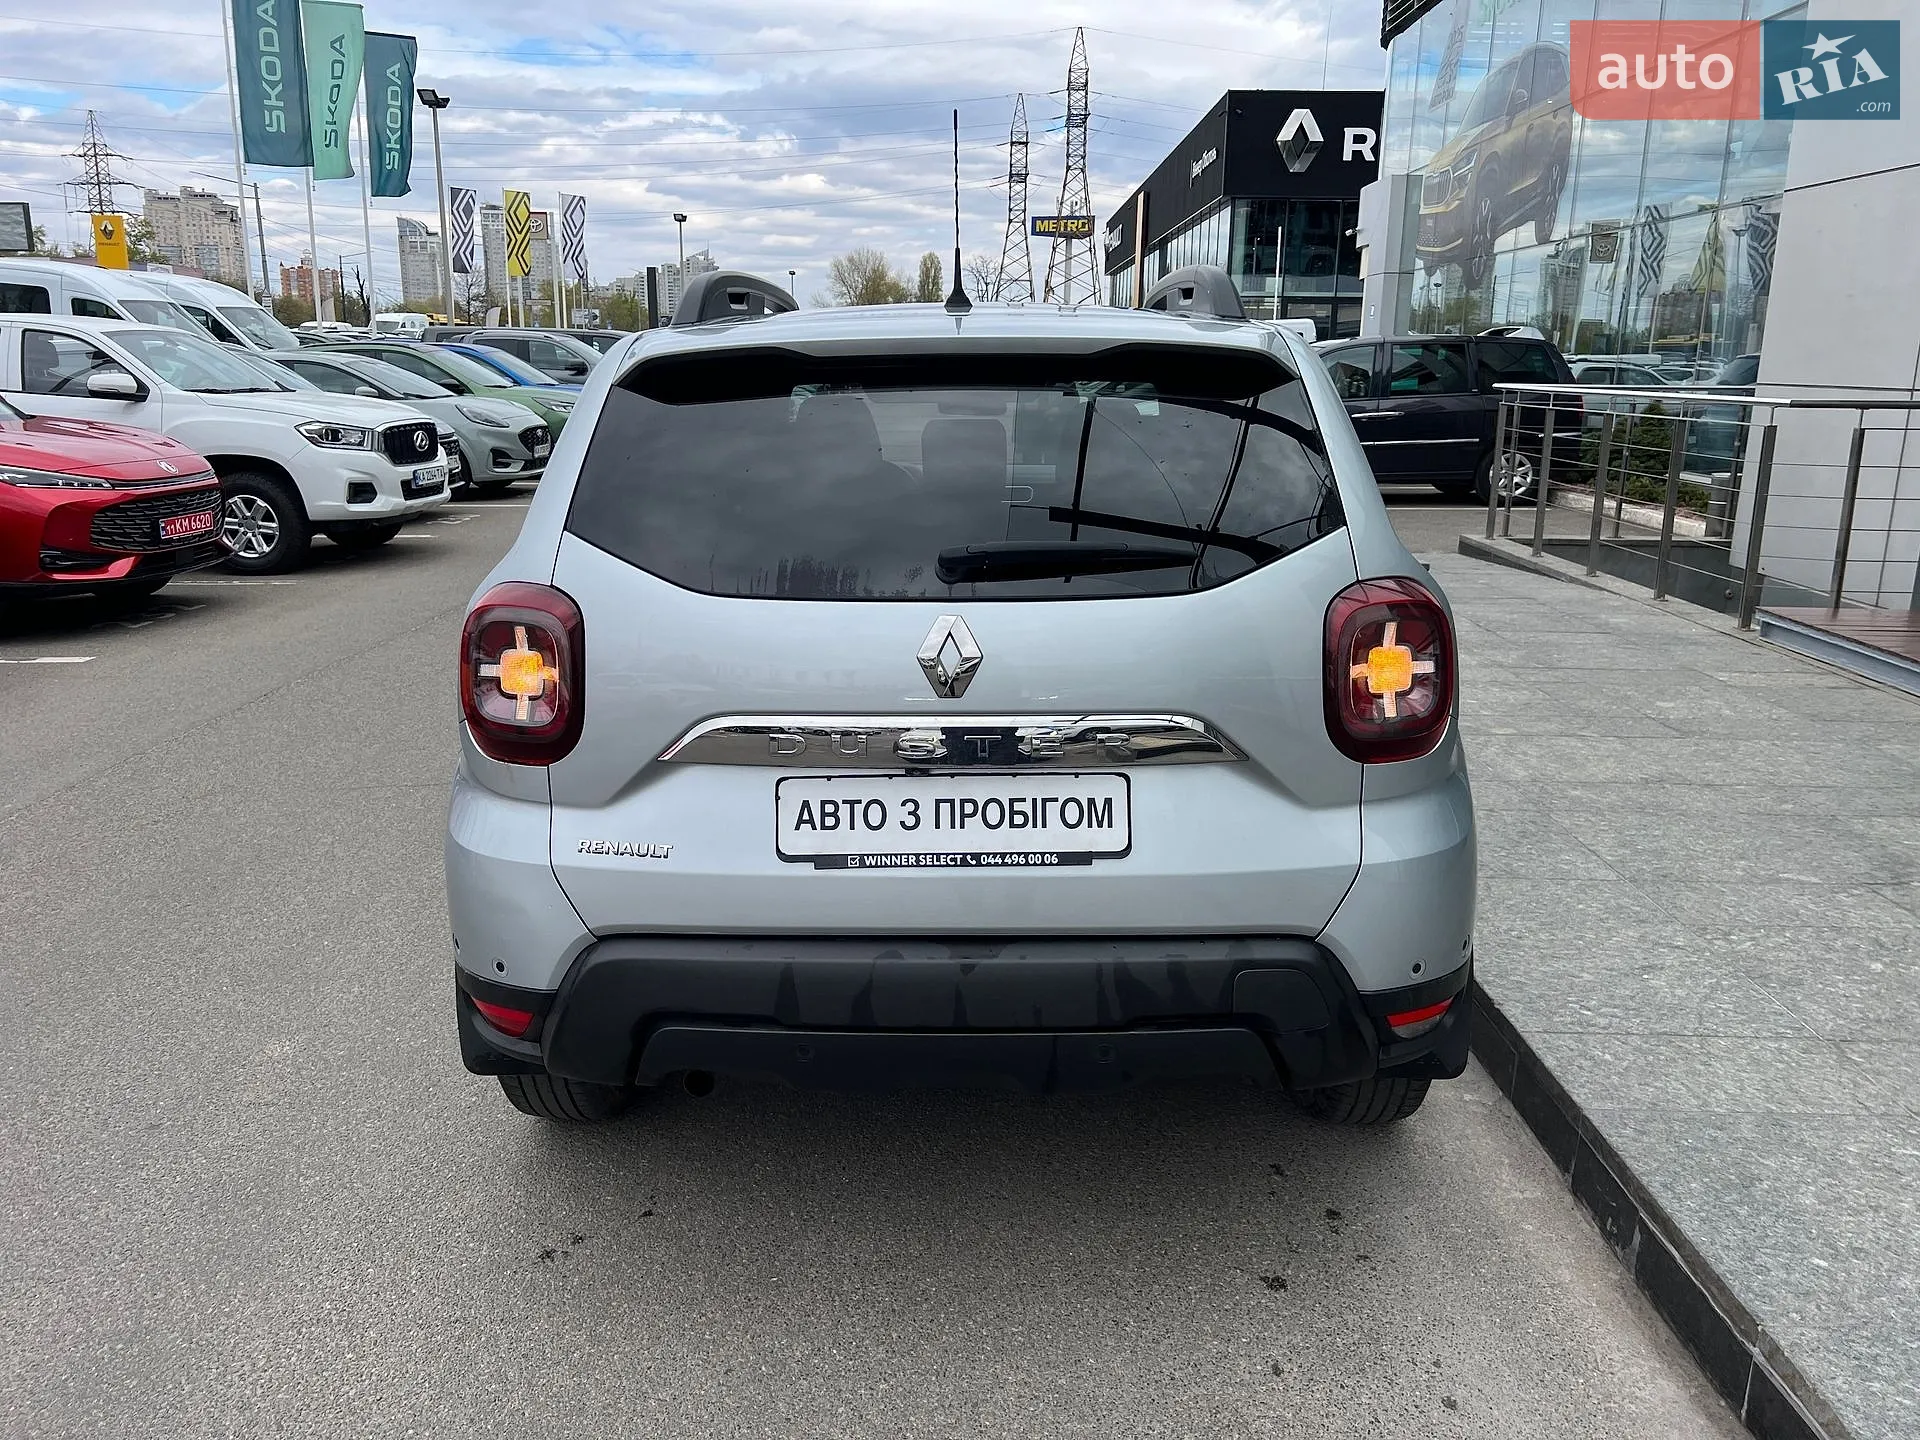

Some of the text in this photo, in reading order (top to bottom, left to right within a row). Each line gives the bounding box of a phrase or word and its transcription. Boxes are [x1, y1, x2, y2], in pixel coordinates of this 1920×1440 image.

[1035, 219, 1092, 233] METRO
[191, 513, 211, 530] 6620
[769, 733, 1132, 759] DUSTER
[794, 797, 1113, 831] АВТО З ПРОБІГОМ
[577, 839, 673, 859] RENAULT
[863, 853, 1059, 866] WINNER SELECT 044 496 00 06
